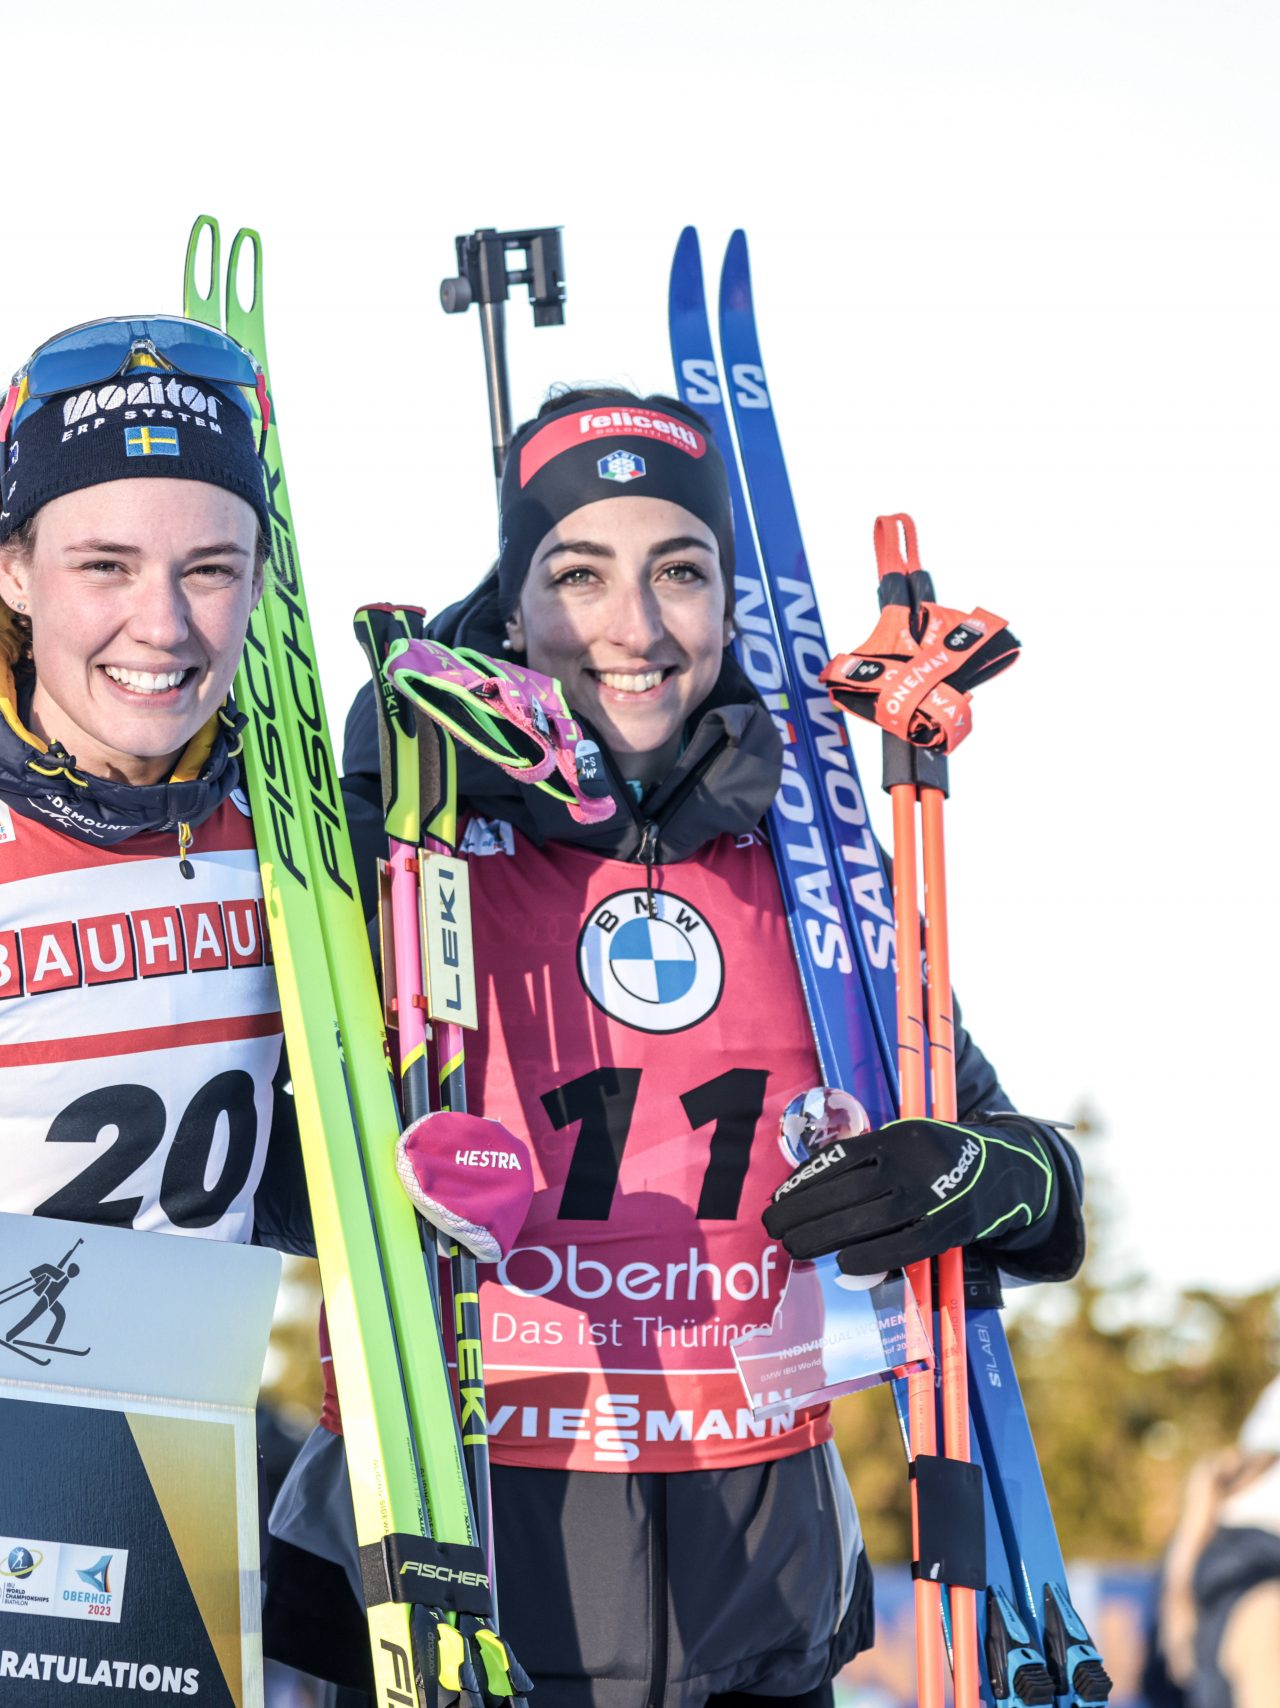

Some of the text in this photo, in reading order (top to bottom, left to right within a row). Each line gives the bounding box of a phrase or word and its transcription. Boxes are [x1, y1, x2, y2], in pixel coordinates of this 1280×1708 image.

[63, 375, 223, 426] monitor
[61, 408, 223, 442] ERP SYSTEM
[579, 411, 698, 450] felicetti
[242, 610, 308, 889] FISC
[777, 576, 898, 975] SALOMON
[438, 867, 462, 1012] LEKI
[32, 1069, 258, 1230] 20
[454, 1149, 522, 1171] HESTRA
[539, 1066, 772, 1221] 11
[492, 1312, 563, 1345] Das
[577, 1312, 624, 1347] ist
[454, 1292, 488, 1447] LEKI
[486, 1393, 796, 1462] VIESSMANN
[399, 1559, 490, 1590] FISCHER
[4, 1599, 29, 1607] BIATHLON
[5, 1593, 50, 1603] CHAMPIONSHIPS
[62, 1590, 113, 1605] OBERHOF
[87, 1604, 112, 1617] 2023
